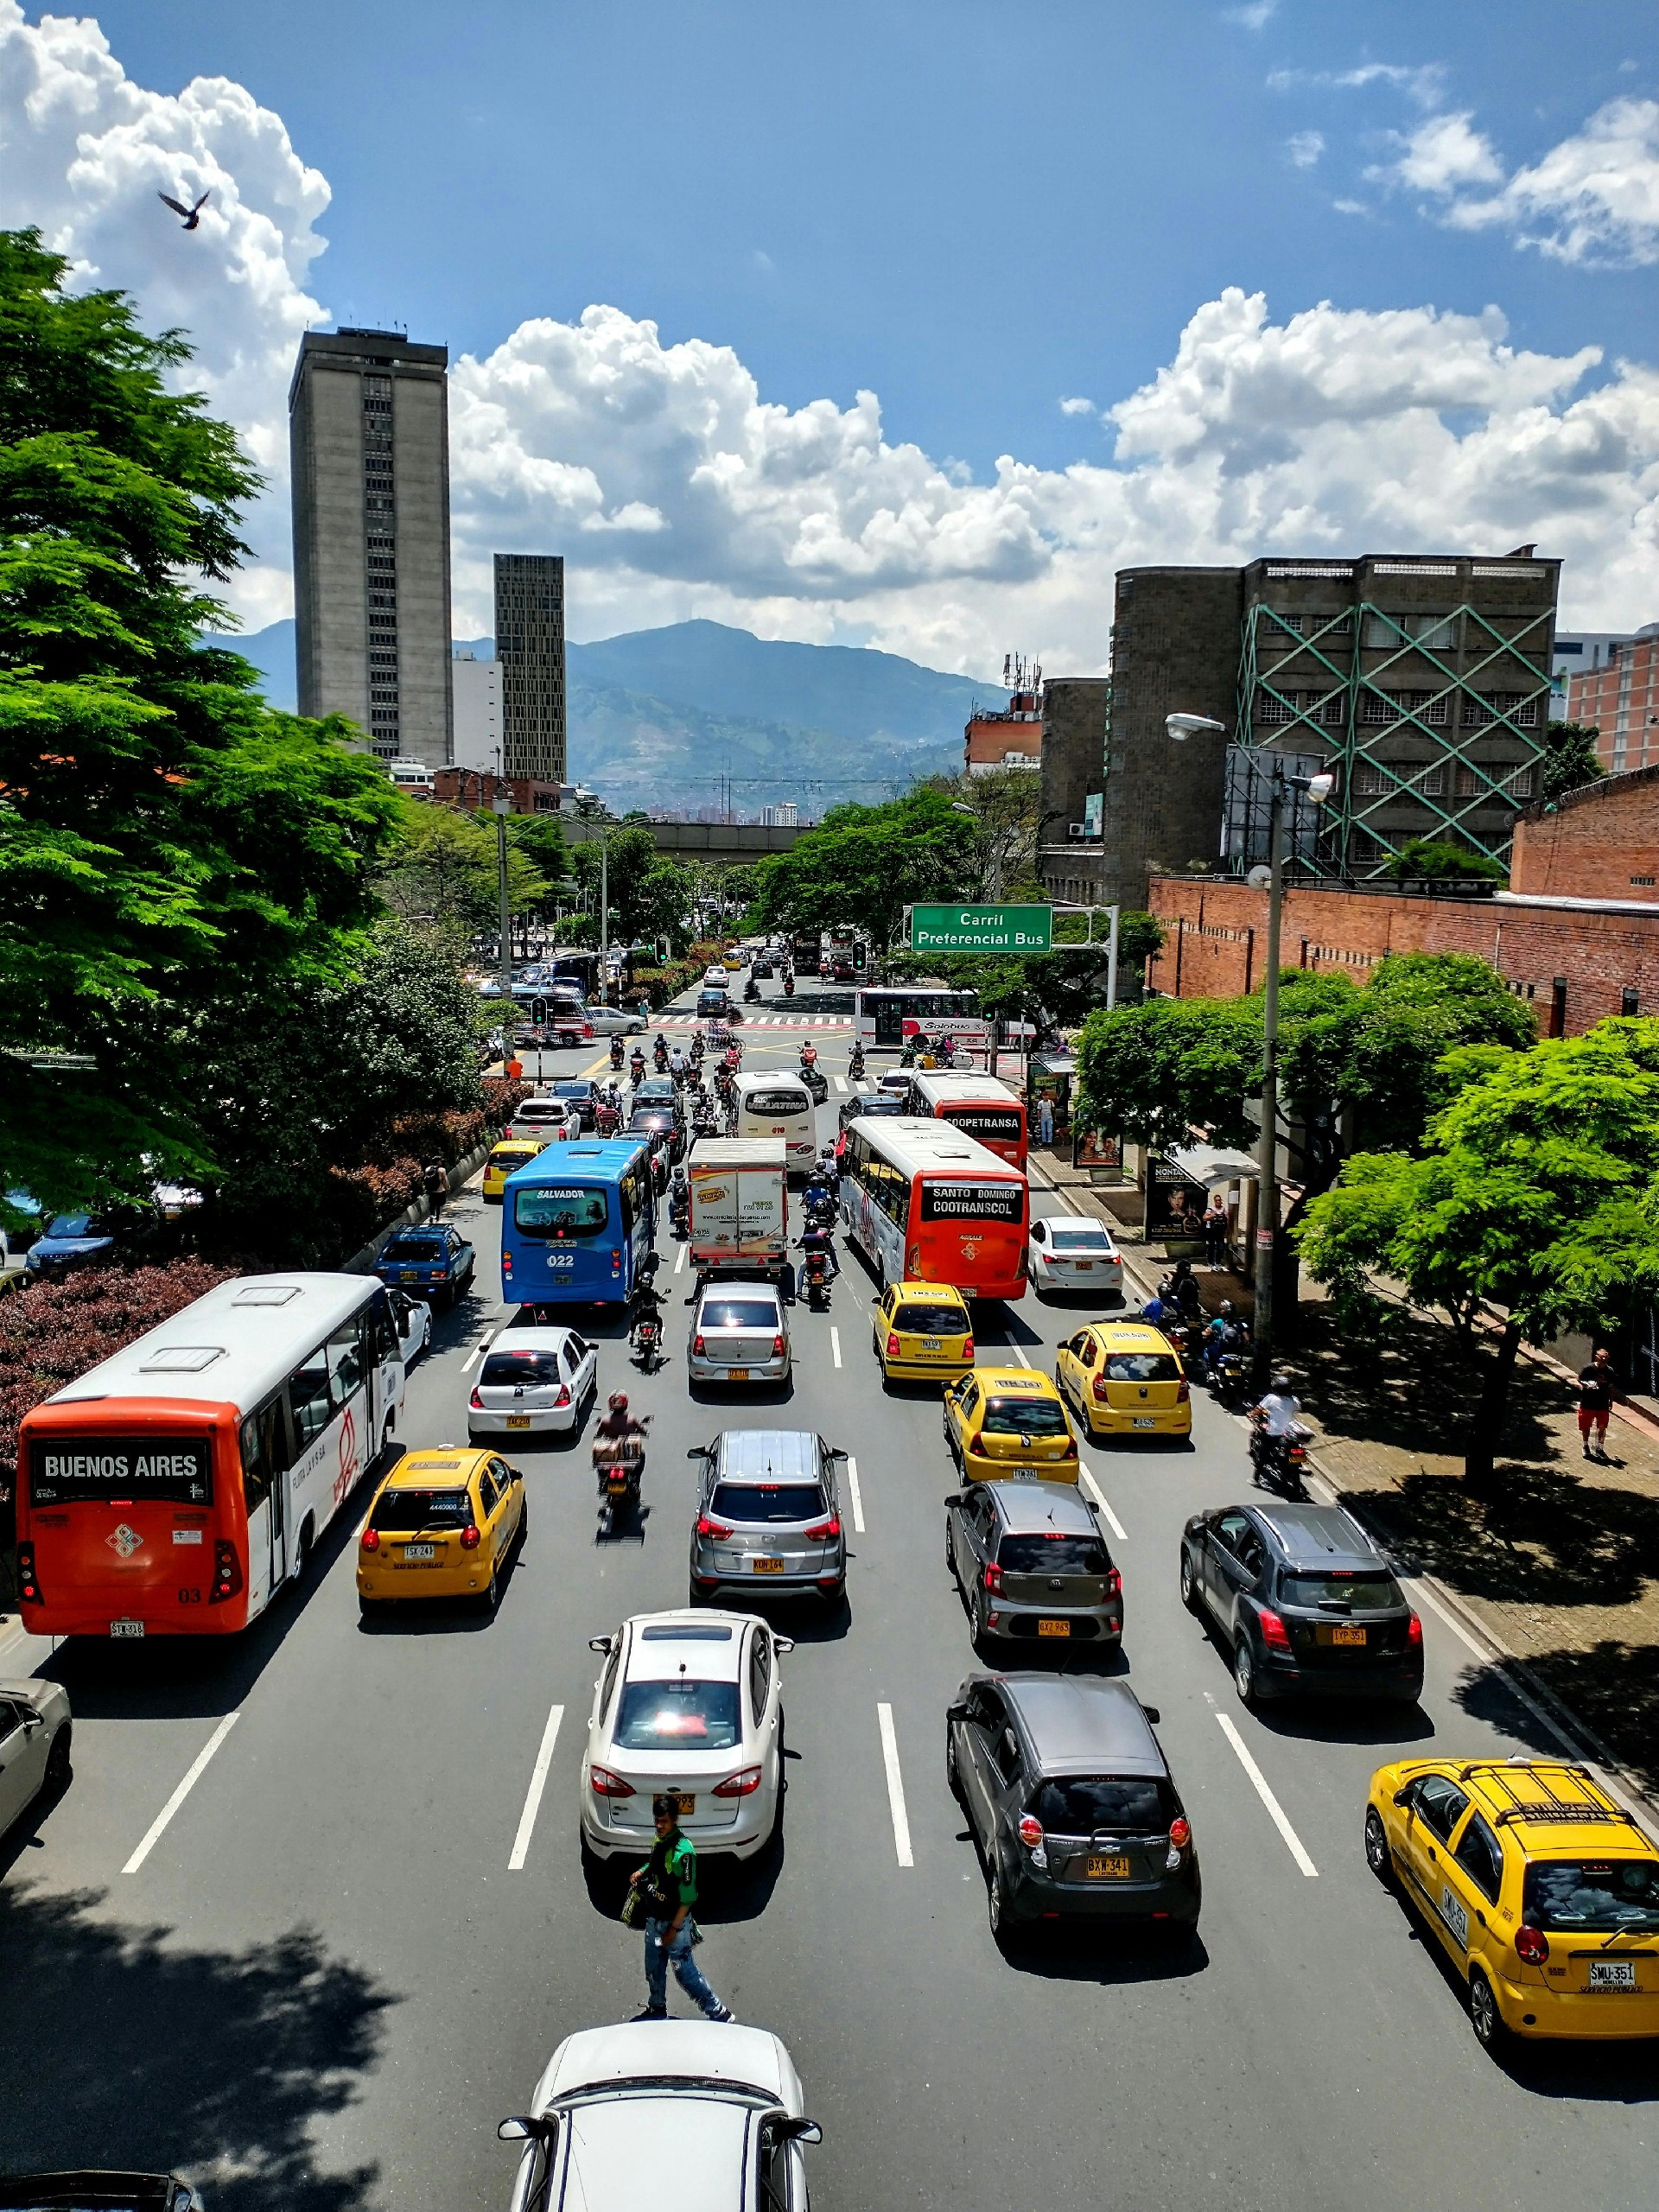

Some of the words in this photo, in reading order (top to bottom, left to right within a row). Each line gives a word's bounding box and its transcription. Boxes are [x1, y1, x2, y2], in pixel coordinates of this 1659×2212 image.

[960, 912, 1004, 926] Carril
[918, 931, 1008, 944] Preferencial
[1014, 932, 1044, 944] Bus
[924, 1021, 969, 1030] Solobus
[772, 1126, 785, 1135] 010
[537, 1190, 586, 1199] SALVADOR
[933, 1188, 971, 1198] SANTO
[978, 1189, 1016, 1199] DOMINGO
[933, 1201, 1013, 1215] COOTRANSCOL
[546, 1255, 575, 1268] 022
[45, 1456, 129, 1478] BUENOS
[134, 1455, 198, 1478] AIRES
[292, 1468, 306, 1492] FLOTA
[178, 1589, 202, 1604] 03
[1334, 1630, 1349, 1640] IYP
[1351, 1630, 1364, 1641] 351
